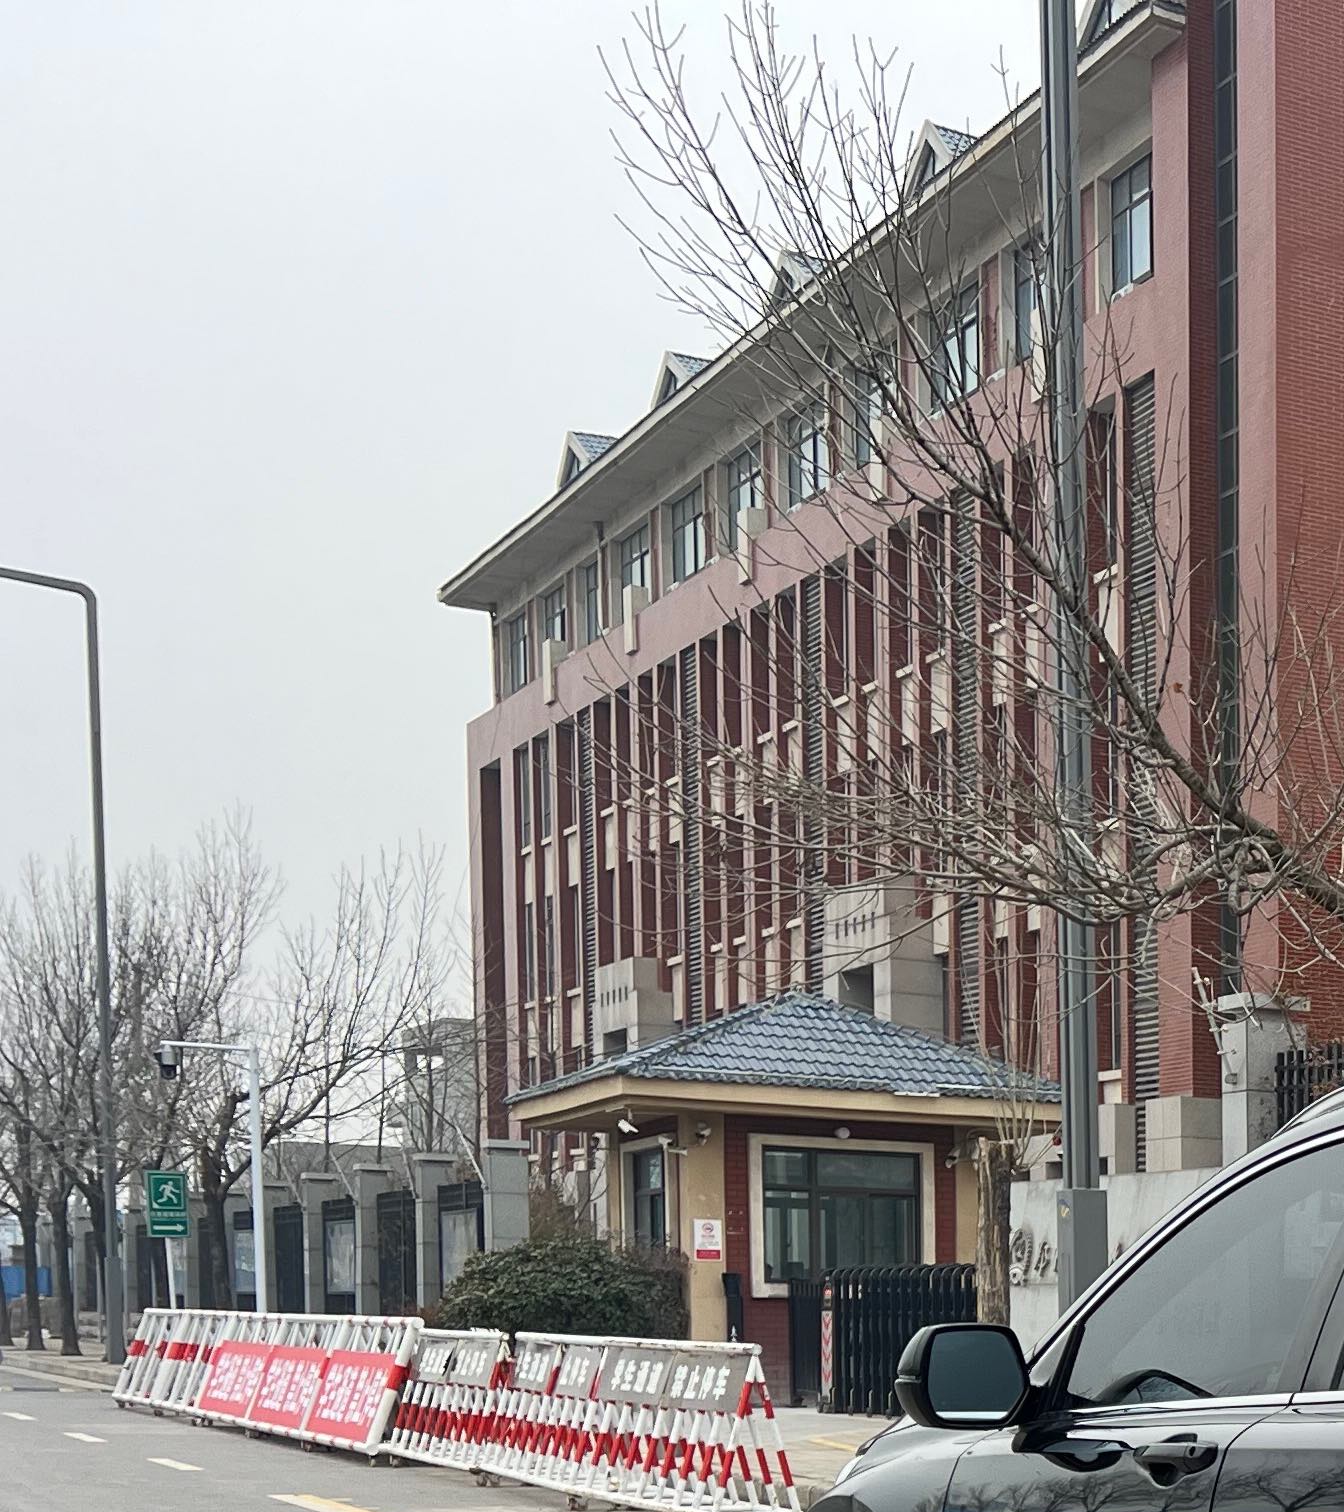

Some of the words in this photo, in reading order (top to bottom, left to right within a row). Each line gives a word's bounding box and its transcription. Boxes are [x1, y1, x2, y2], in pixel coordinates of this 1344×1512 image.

[611, 1358, 664, 1395] 学生通道
[670, 1364, 732, 1401] 禁止停车
